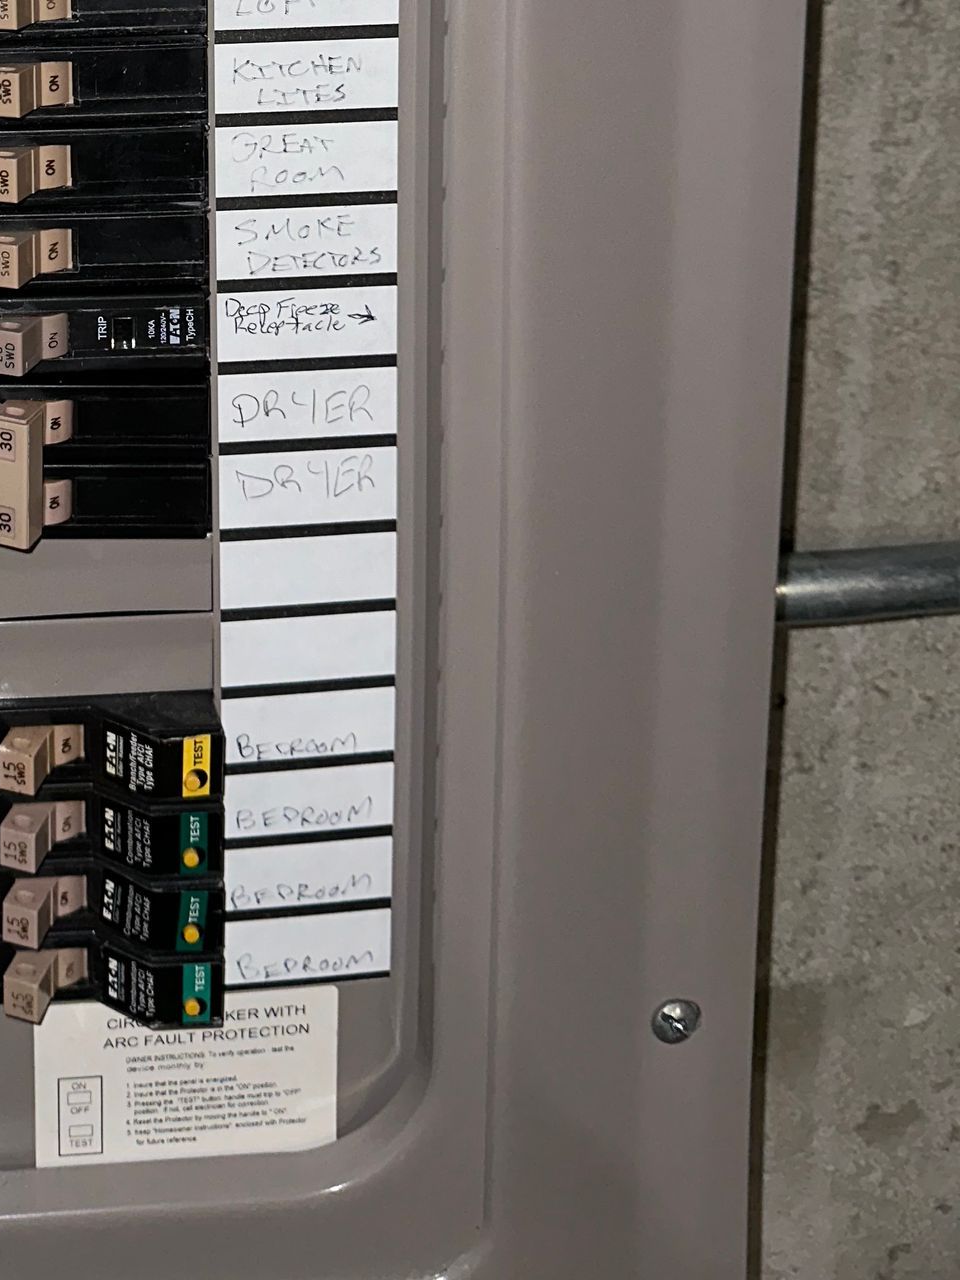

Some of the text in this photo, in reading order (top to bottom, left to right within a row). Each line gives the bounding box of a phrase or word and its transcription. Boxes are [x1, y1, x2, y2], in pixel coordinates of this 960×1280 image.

[232, 53, 363, 84] KITCHEN
[257, 83, 347, 106] LITES
[231, 131, 336, 163] GREAT
[250, 164, 345, 193] ROOM
[234, 214, 356, 246] SMOKE
[247, 246, 383, 276] DETECTORS
[97, 315, 108, 341] TRIP
[4, 342, 16, 369] SWD
[231, 383, 374, 429] DRYER
[0, 431, 13, 452] 30
[235, 454, 376, 501] DRYER
[193, 739, 204, 767] TEST
[235, 732, 358, 761] BEDROOM
[235, 795, 374, 831] BEDROOM
[190, 816, 201, 843] TEST
[229, 872, 372, 909] BEDROOM
[188, 896, 201, 922] TEST
[194, 965, 206, 993] TEST
[235, 949, 375, 981] BEDROOM
[264, 1004, 307, 1019] WITH
[102, 1023, 310, 1050] ARC FAULT PROTECTION
